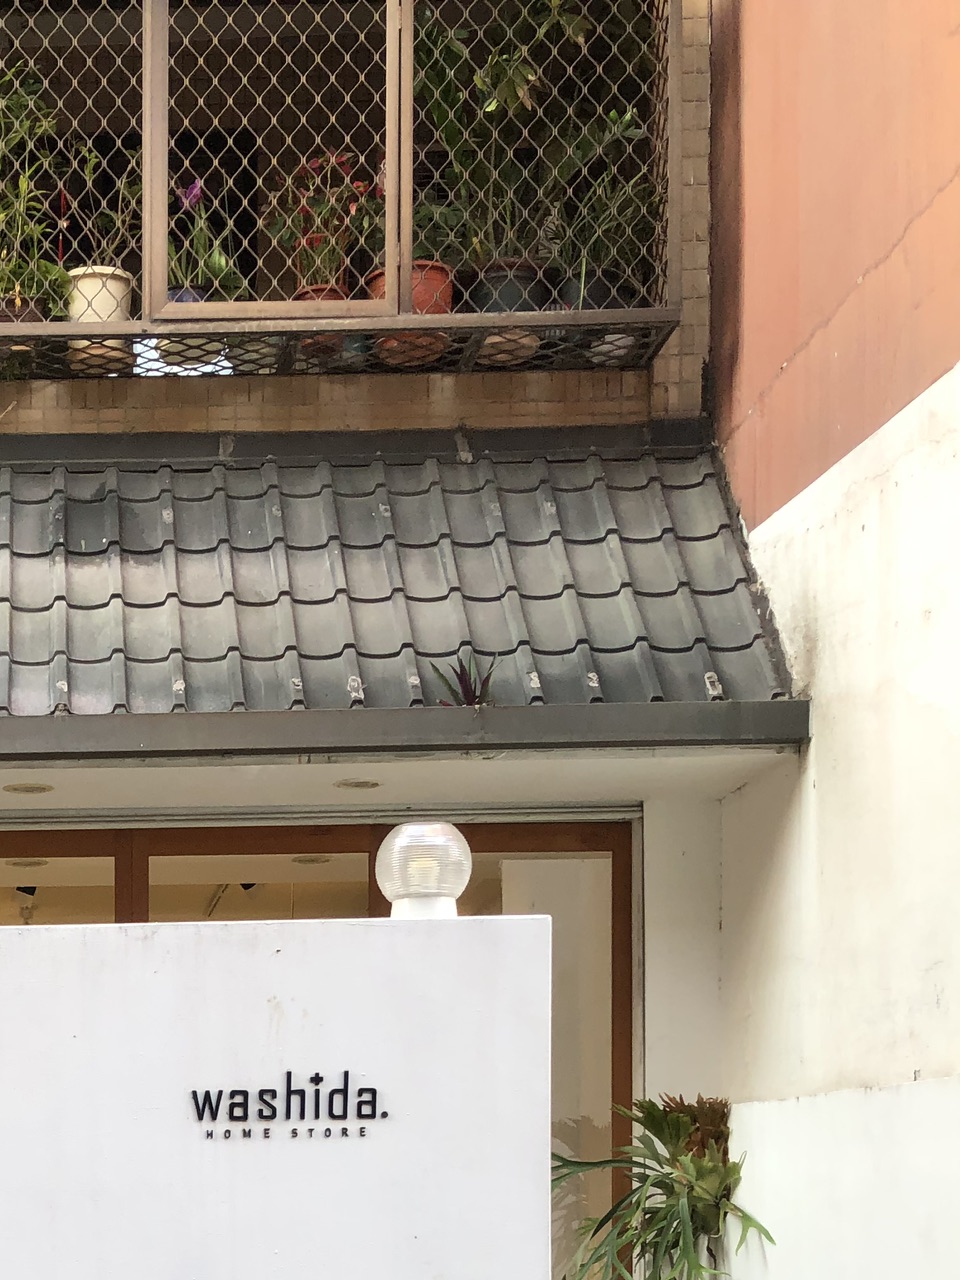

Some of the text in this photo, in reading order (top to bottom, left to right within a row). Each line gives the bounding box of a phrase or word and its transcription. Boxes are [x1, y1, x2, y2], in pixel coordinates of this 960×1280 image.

[191, 1070, 389, 1122] washida.
[206, 1126, 367, 1140] HOME STORE
